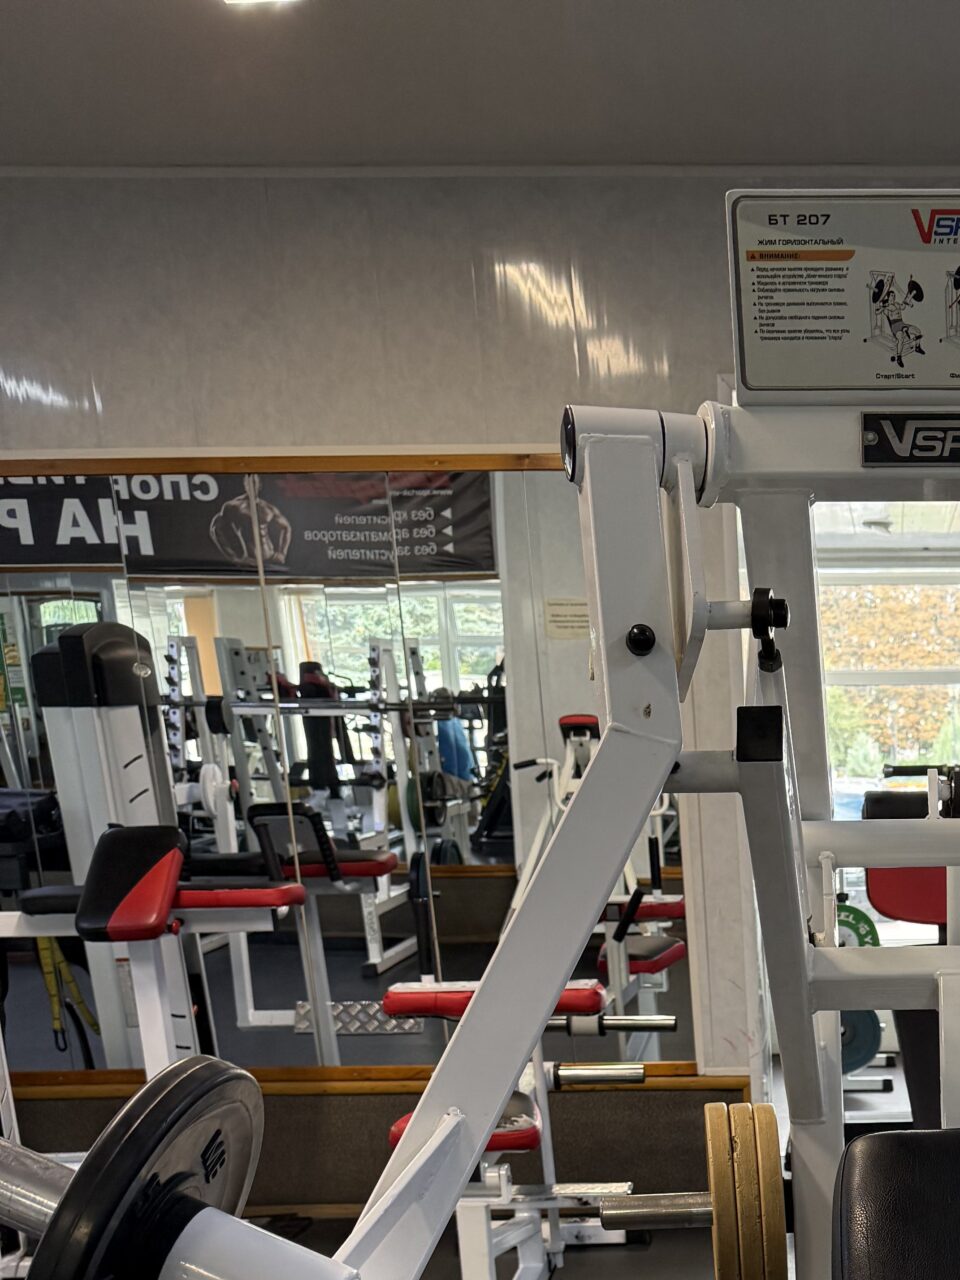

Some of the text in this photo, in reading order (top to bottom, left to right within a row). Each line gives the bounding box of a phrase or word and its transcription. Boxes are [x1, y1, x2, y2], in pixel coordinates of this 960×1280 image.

[768, 214, 832, 226] БТ 207
[778, 237, 844, 246] ГОРИЗОНТАЛЬНЫЙ
